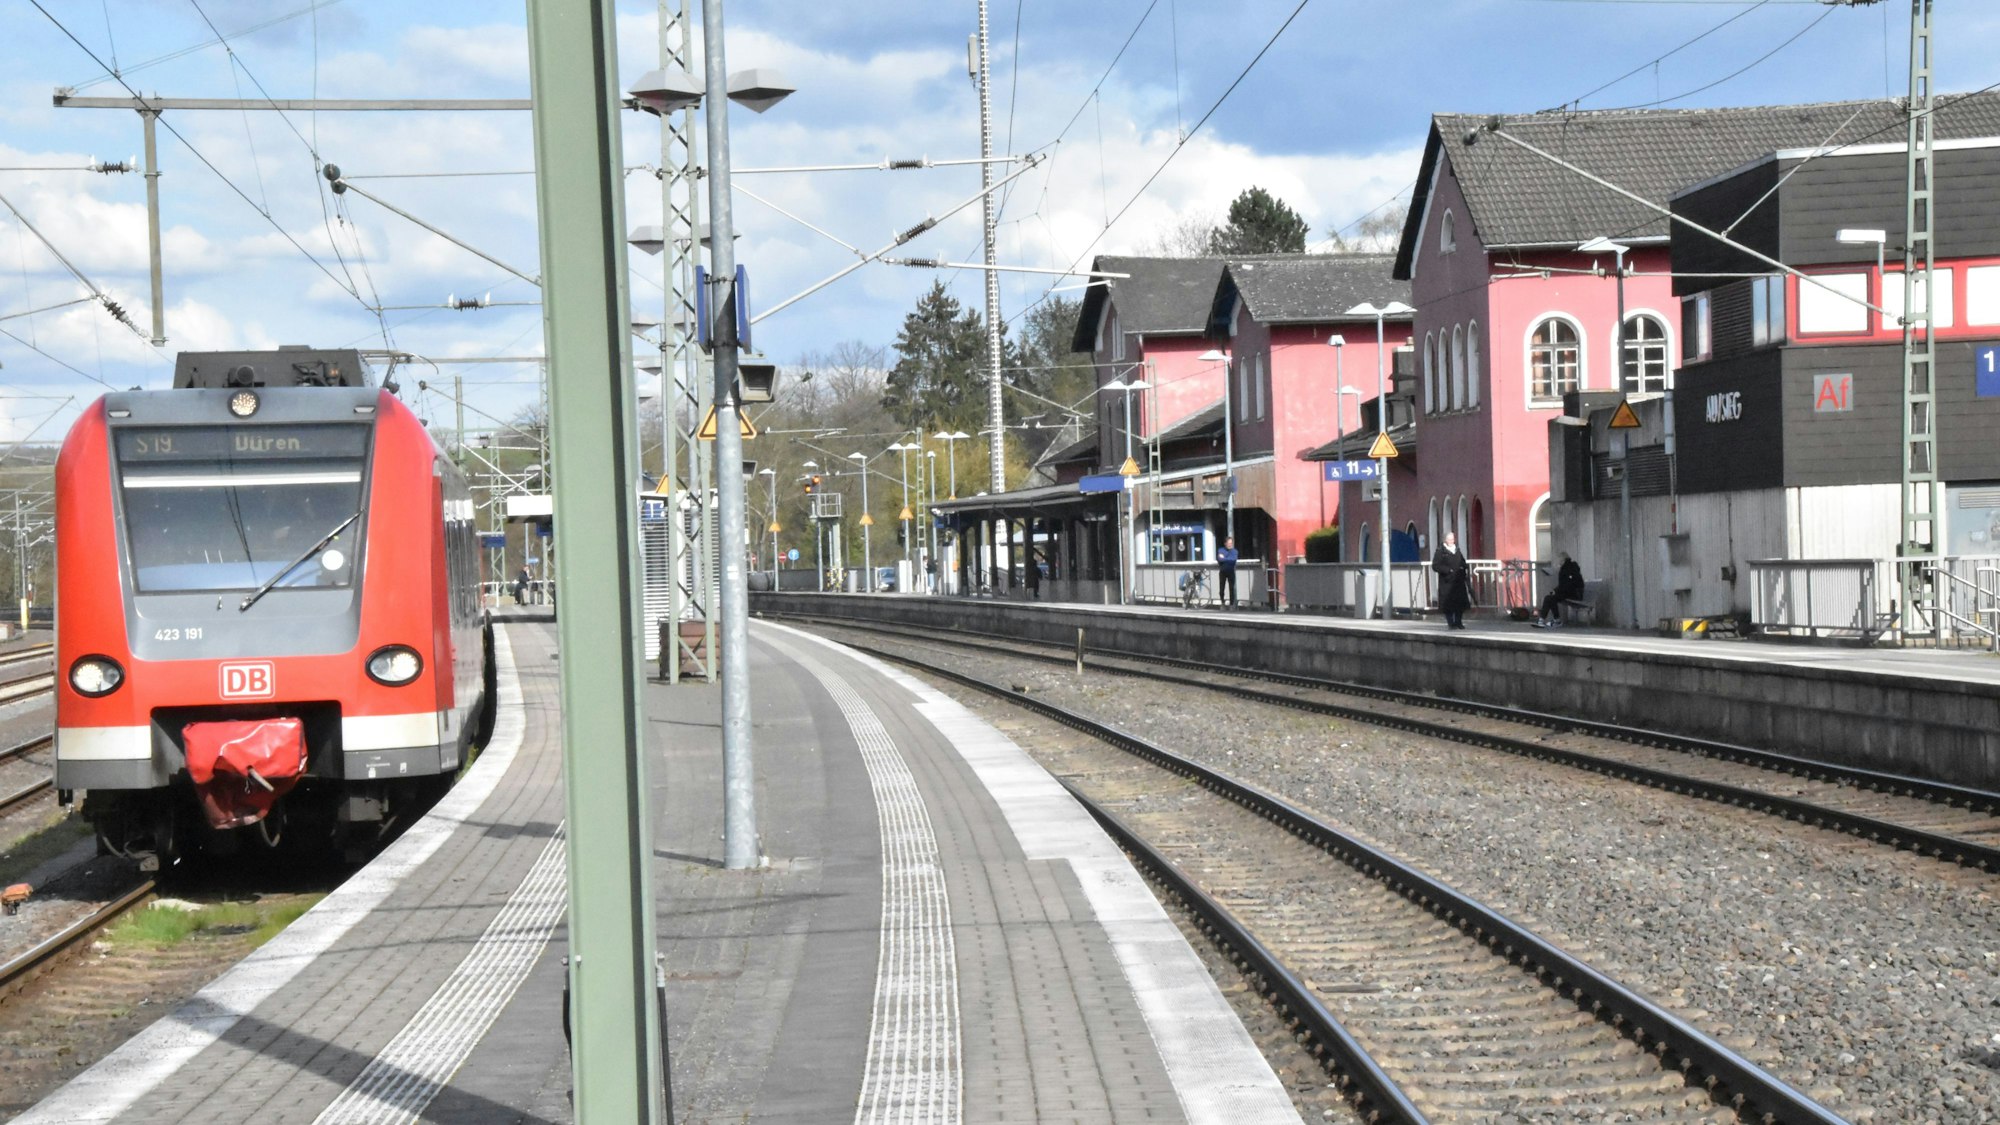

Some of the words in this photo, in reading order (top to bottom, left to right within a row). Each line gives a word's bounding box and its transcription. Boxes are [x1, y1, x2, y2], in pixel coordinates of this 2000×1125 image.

[1983, 350, 1995, 373] 1
[1815, 376, 1850, 409] Af
[154, 628, 180, 641] 423
[184, 627, 203, 640] 191
[226, 667, 268, 693] DB
